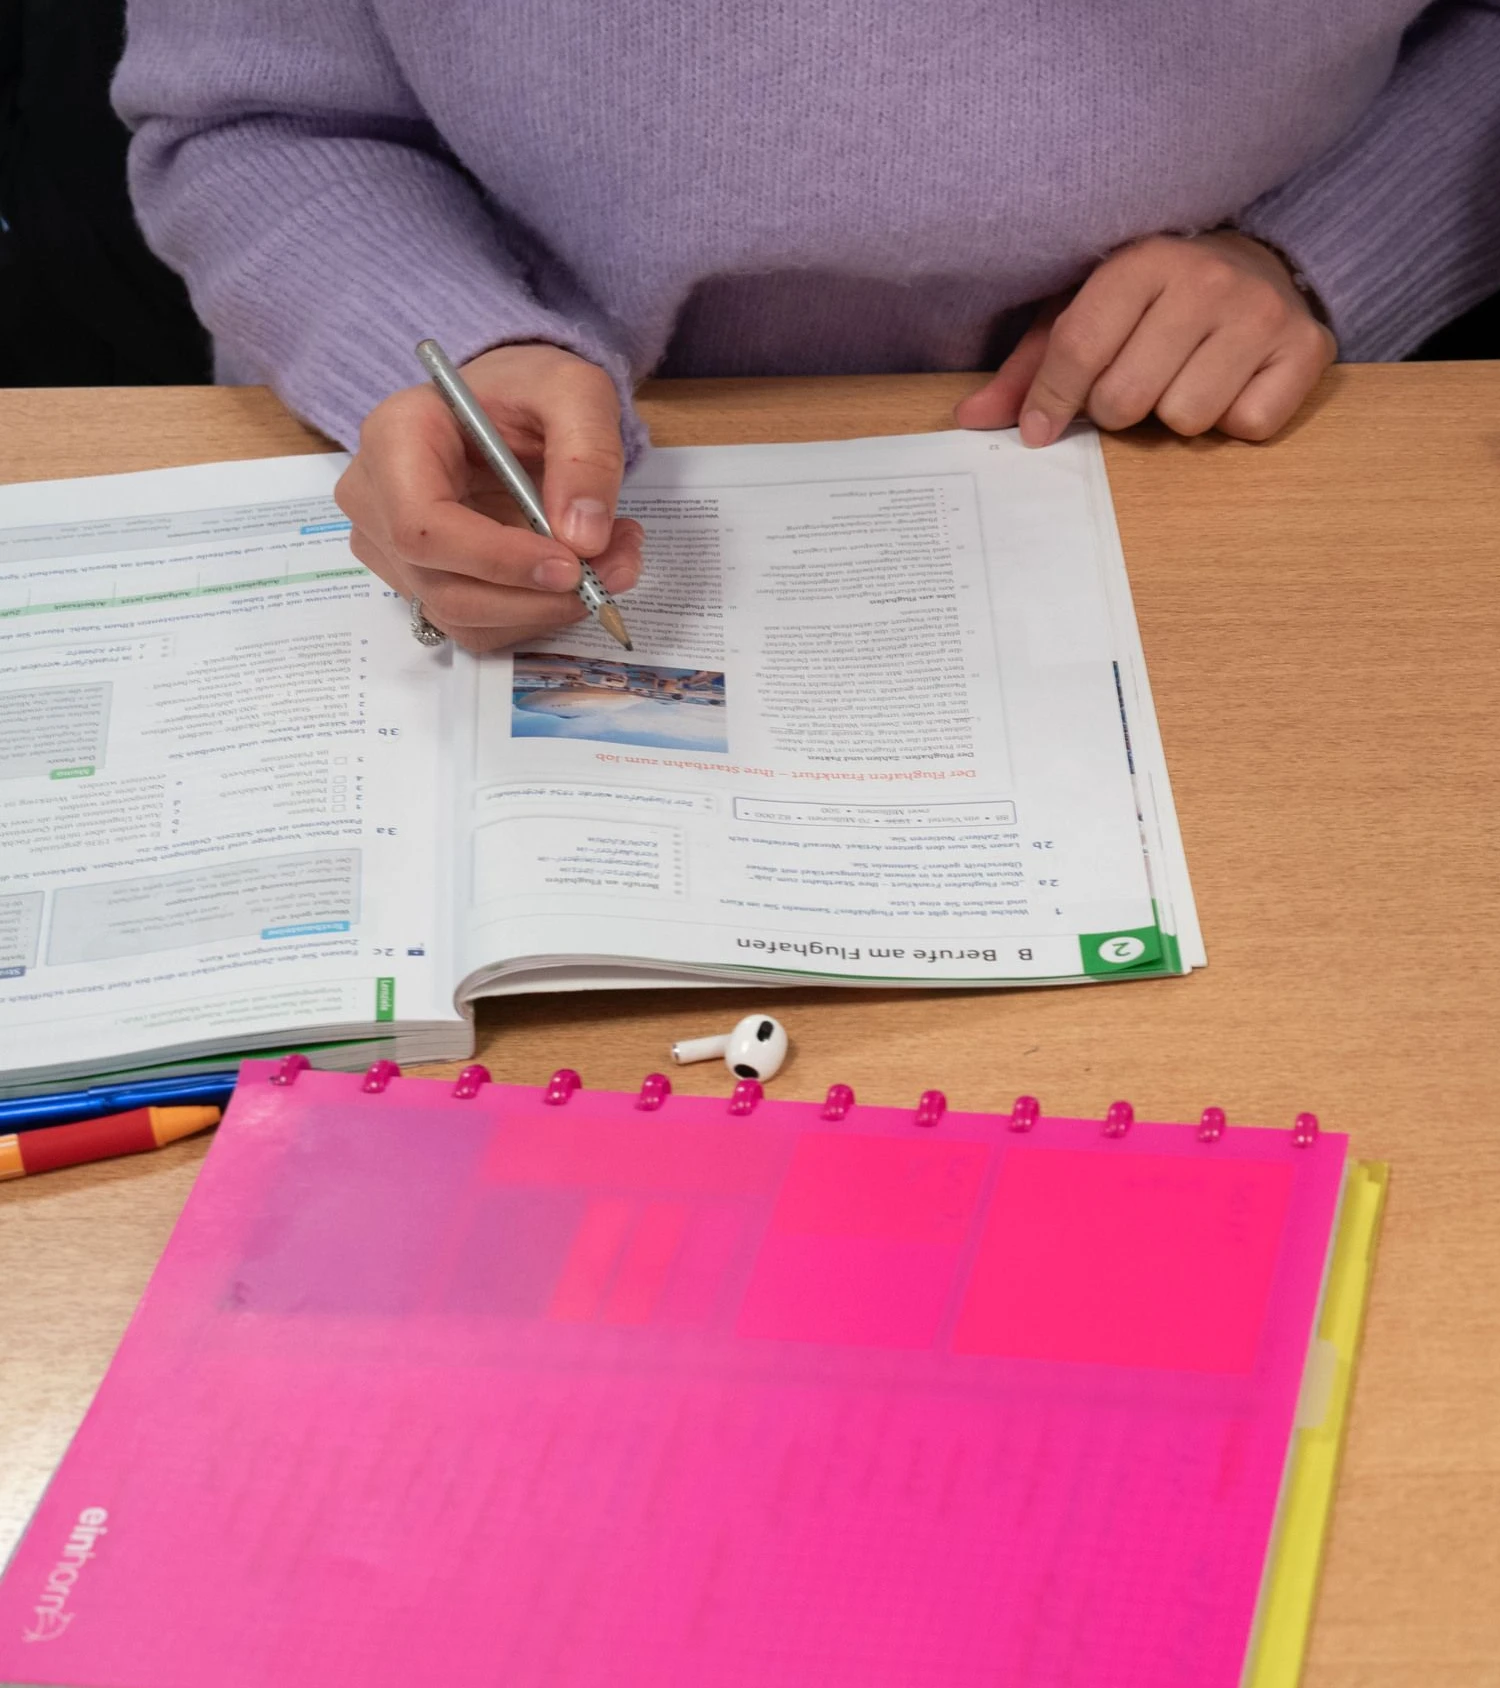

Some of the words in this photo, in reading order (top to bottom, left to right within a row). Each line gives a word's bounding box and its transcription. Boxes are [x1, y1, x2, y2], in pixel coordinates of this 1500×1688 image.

[594, 753, 619, 763] Job
[624, 756, 658, 766] zum
[662, 759, 740, 774] Startbahn
[744, 767, 775, 778] Ihre
[791, 771, 865, 782] Frankfurt
[868, 770, 945, 782] Flughafen
[949, 769, 976, 779] Der
[736, 938, 860, 960] Flughafen
[868, 948, 904, 959] am
[1018, 949, 1033, 960] B
[1112, 942, 1131, 957] 2
[912, 948, 996, 963] Berufe
[34, 1506, 109, 1614] einhorn
